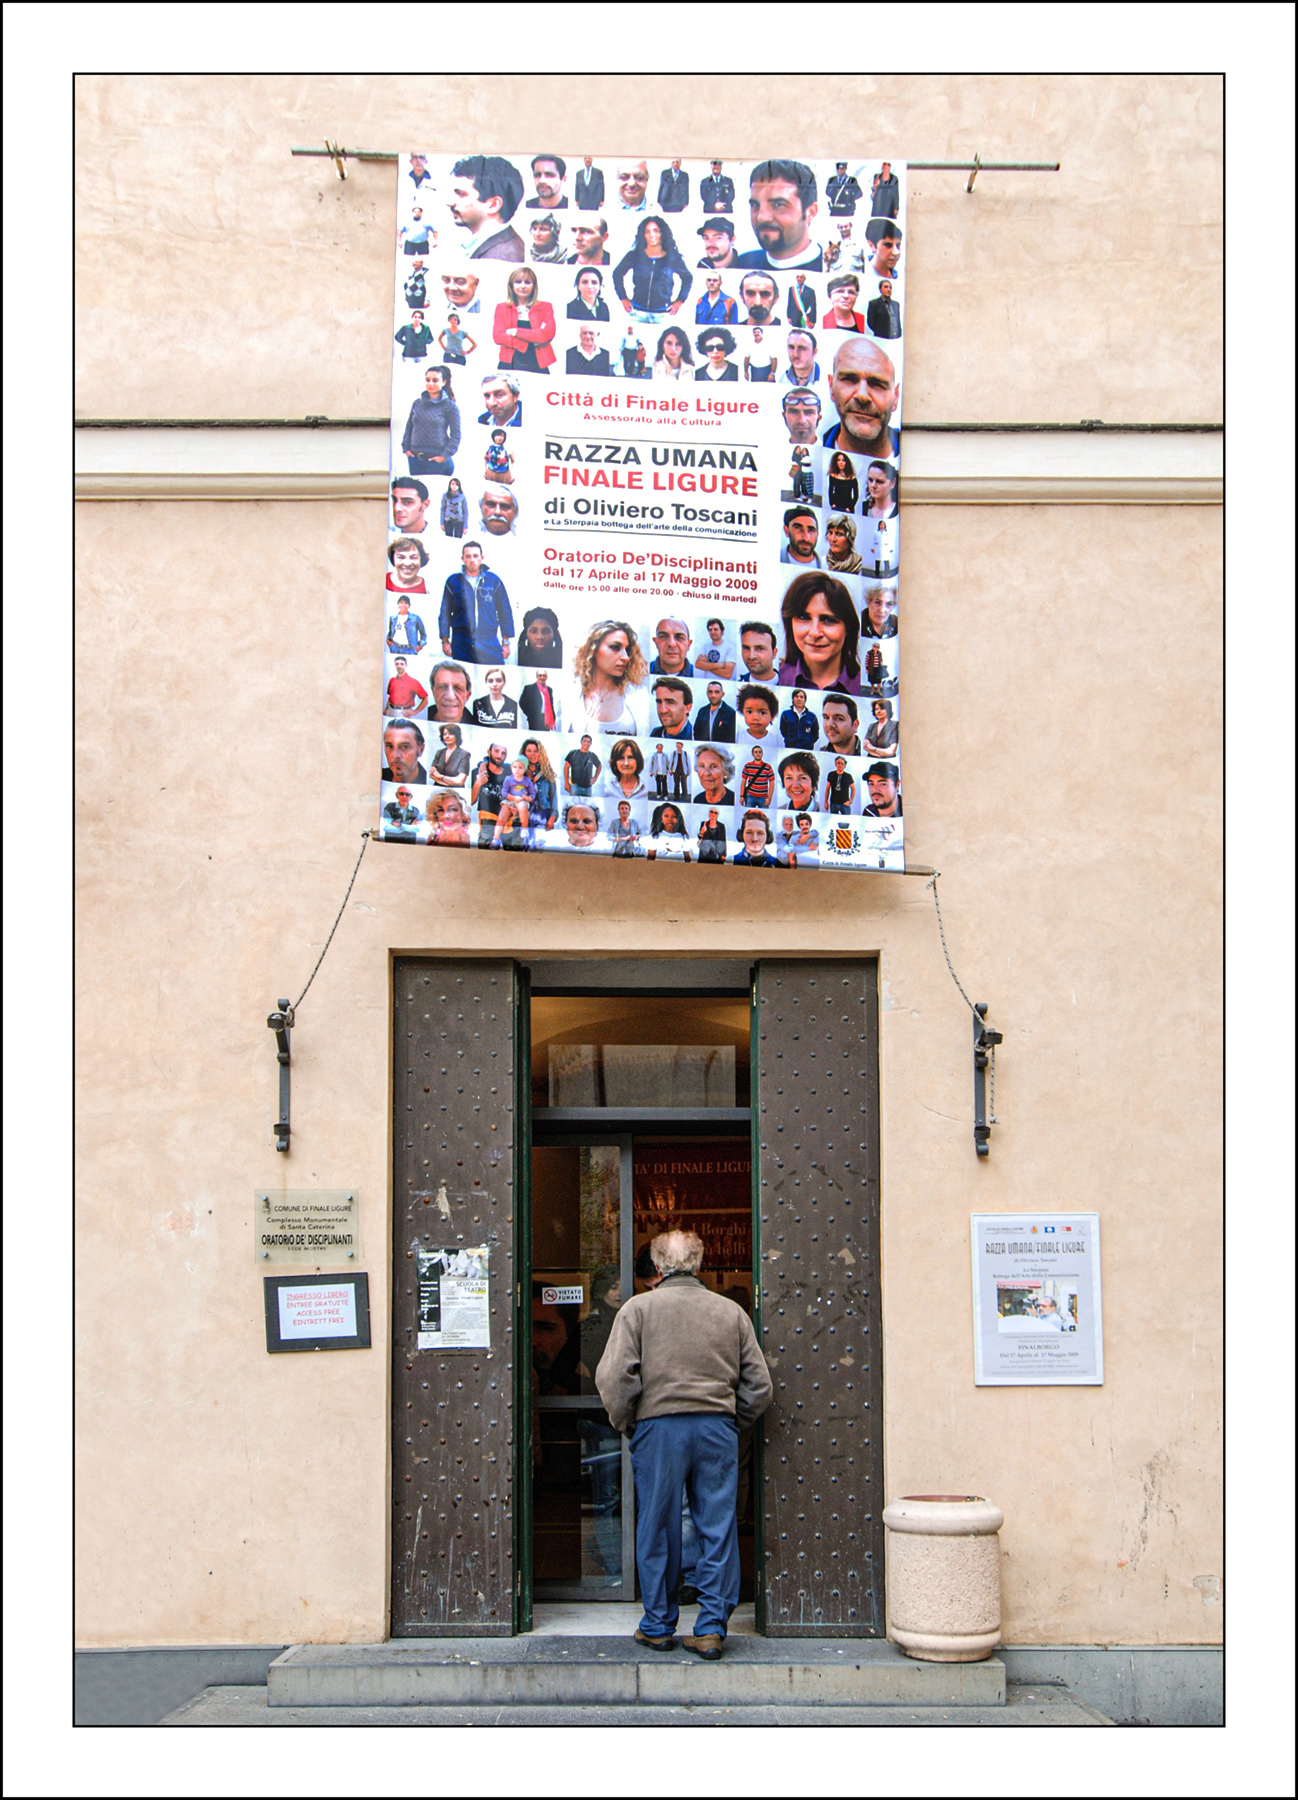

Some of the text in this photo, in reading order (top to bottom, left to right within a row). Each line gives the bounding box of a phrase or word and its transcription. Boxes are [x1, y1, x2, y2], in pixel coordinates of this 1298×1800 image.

[546, 392, 759, 416] Città di Finale Ligure
[584, 413, 721, 426] Assessorato alla Cultura
[545, 442, 758, 471] RAZZA UMANA
[544, 466, 758, 497] FINALE LIGURE
[545, 497, 757, 526] di Oliviero Toscani
[564, 518, 598, 527] Sterpaia
[601, 521, 633, 529] bottega
[636, 522, 670, 531] dell'arte
[672, 524, 692, 532] della
[695, 526, 757, 537] comunicazione
[544, 548, 757, 574] Oratorio De'Disciplinanti
[543, 566, 758, 590] dal 17 Aprile al 17 Maggio 2009
[543, 581, 566, 589] dalle
[650, 588, 674, 596] 20.00
[682, 591, 712, 600] chiuso
[714, 592, 719, 600] il
[654, 1163, 667, 1174] DI
[671, 1162, 713, 1173] FINALE
[702, 1222, 746, 1238] Borghi
[261, 1235, 353, 1245] ORATORIO DE' DISCIPLINANTI
[986, 1243, 1006, 1254] RAZZA
[1062, 1241, 1085, 1253] LIGURE
[314, 1299, 348, 1307] GRATUITE
[324, 1291, 348, 1299] LIBERO
[293, 1318, 326, 1326] EINTRITT
